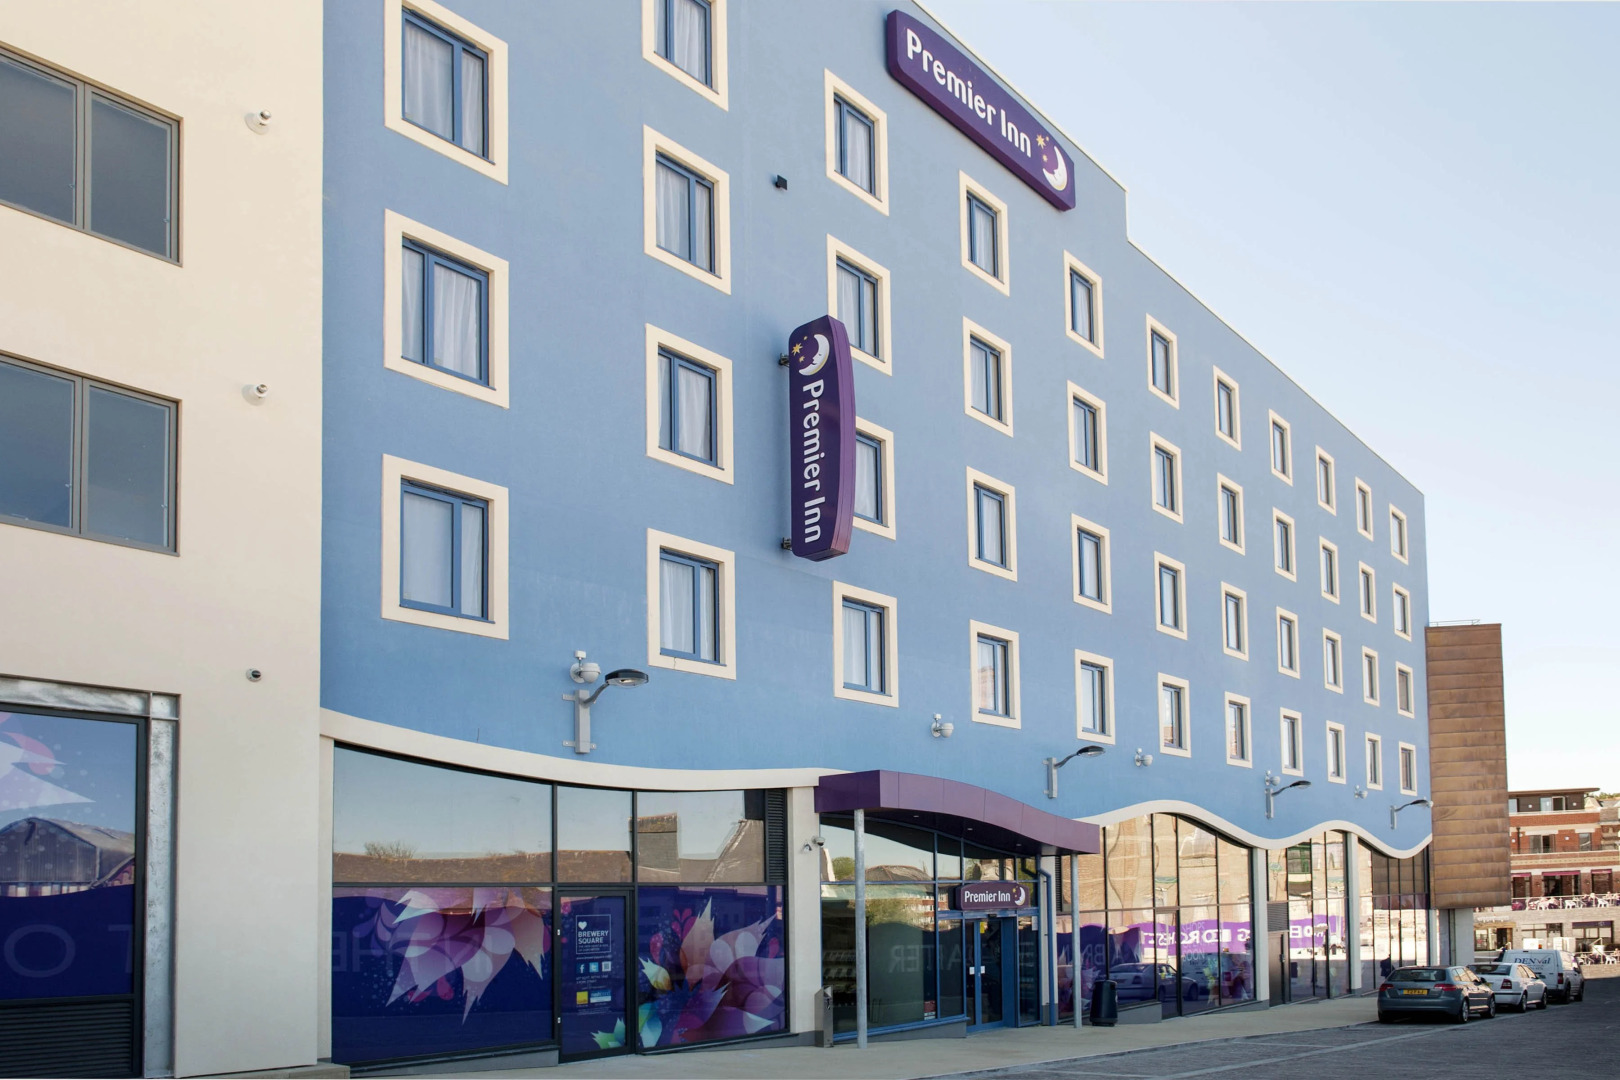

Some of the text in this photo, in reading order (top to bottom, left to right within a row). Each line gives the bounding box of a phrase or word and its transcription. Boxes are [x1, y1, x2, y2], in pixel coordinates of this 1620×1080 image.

[906, 28, 1032, 158] Premier Inn
[802, 379, 826, 543] Premier Inn
[964, 890, 1011, 903] Premier Inn
[578, 930, 609, 938] BREWERY
